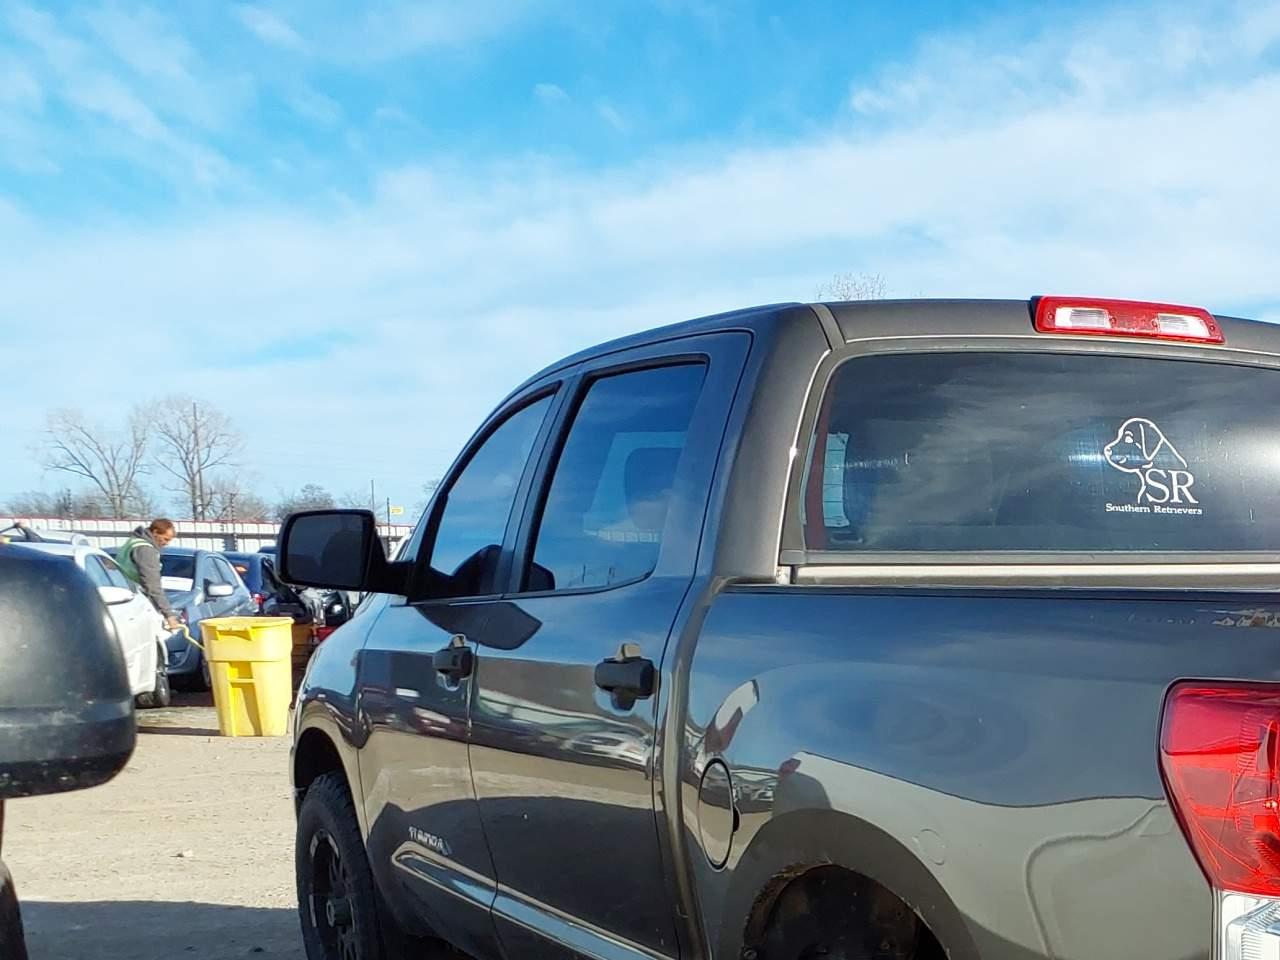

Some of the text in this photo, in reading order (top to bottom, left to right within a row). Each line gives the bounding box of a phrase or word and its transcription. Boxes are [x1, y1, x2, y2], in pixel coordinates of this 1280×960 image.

[1145, 468, 1199, 504] SR
[1105, 502, 1203, 515] Southern Retrievers
